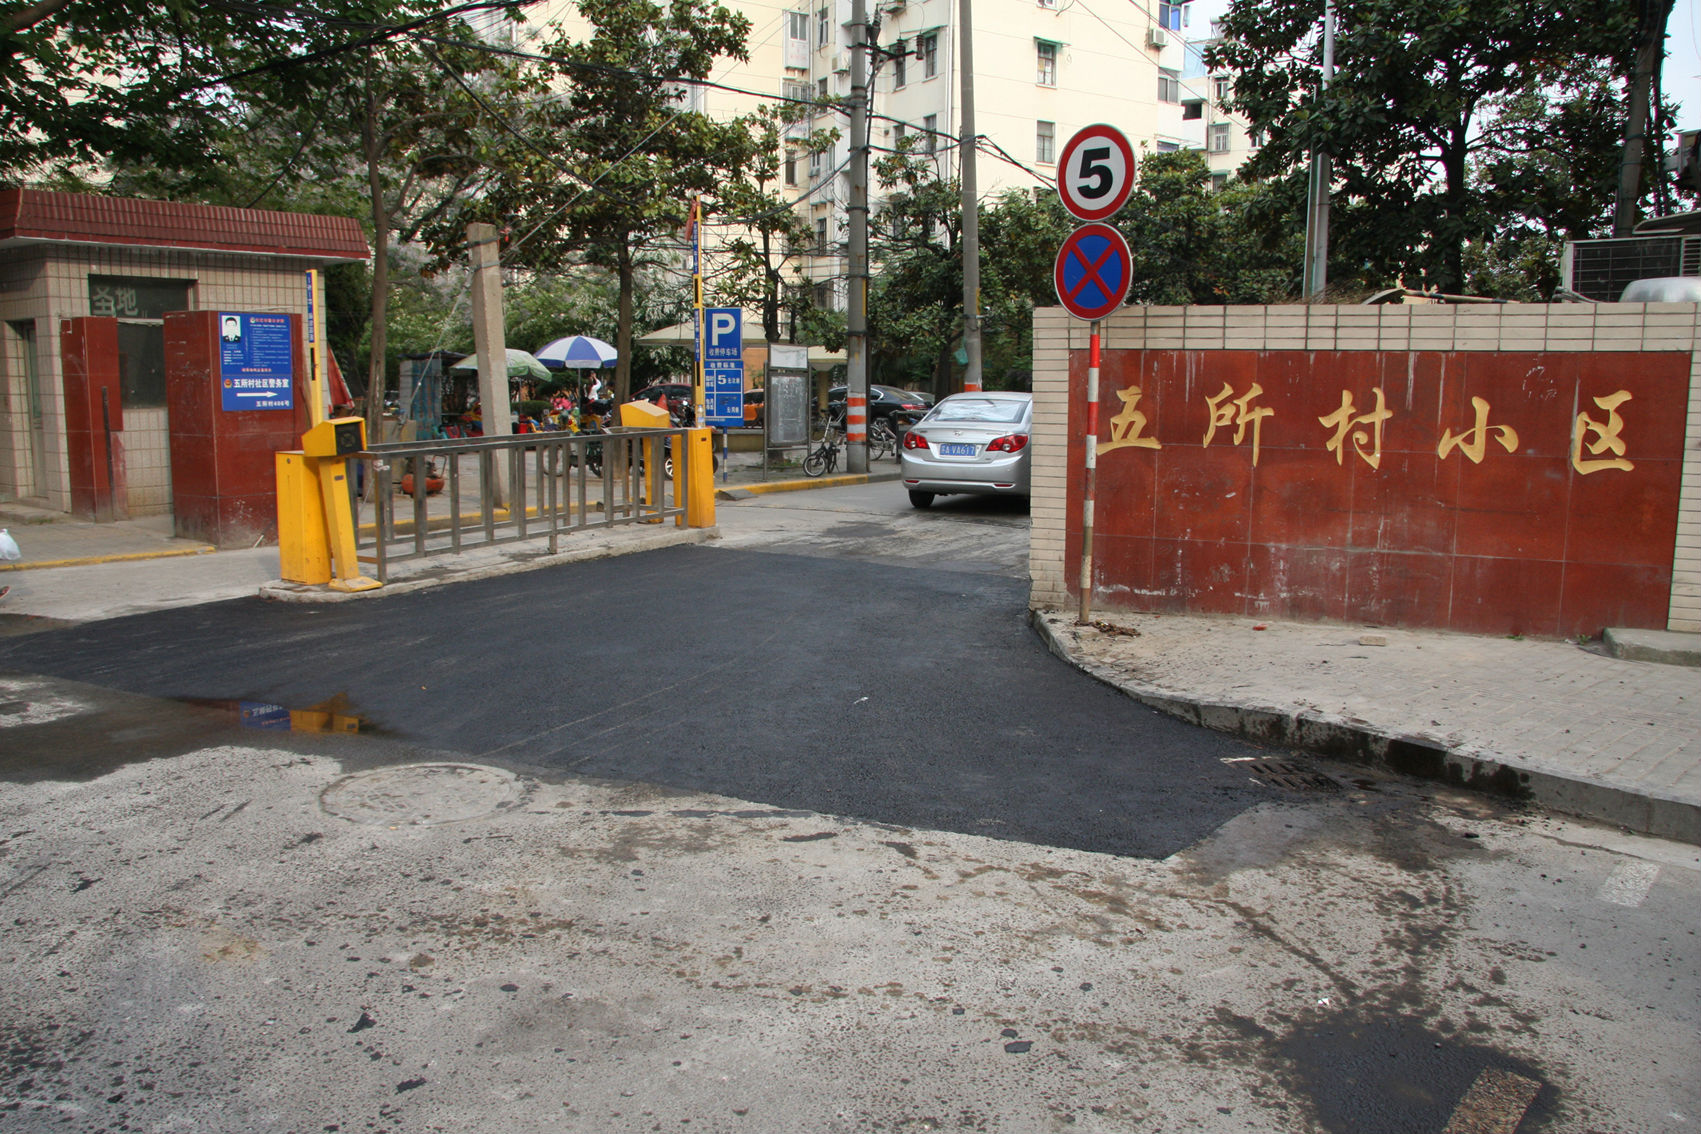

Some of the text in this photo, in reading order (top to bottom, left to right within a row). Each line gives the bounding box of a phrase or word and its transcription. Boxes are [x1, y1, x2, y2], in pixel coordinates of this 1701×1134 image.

[1077, 147, 1114, 200] 5
[712, 313, 736, 346] P
[709, 347, 738, 356] 收费停车场
[233, 378, 290, 389] 五所村社区警务室
[717, 374, 727, 385] 5
[1096, 382, 1634, 474] 五所村小区
